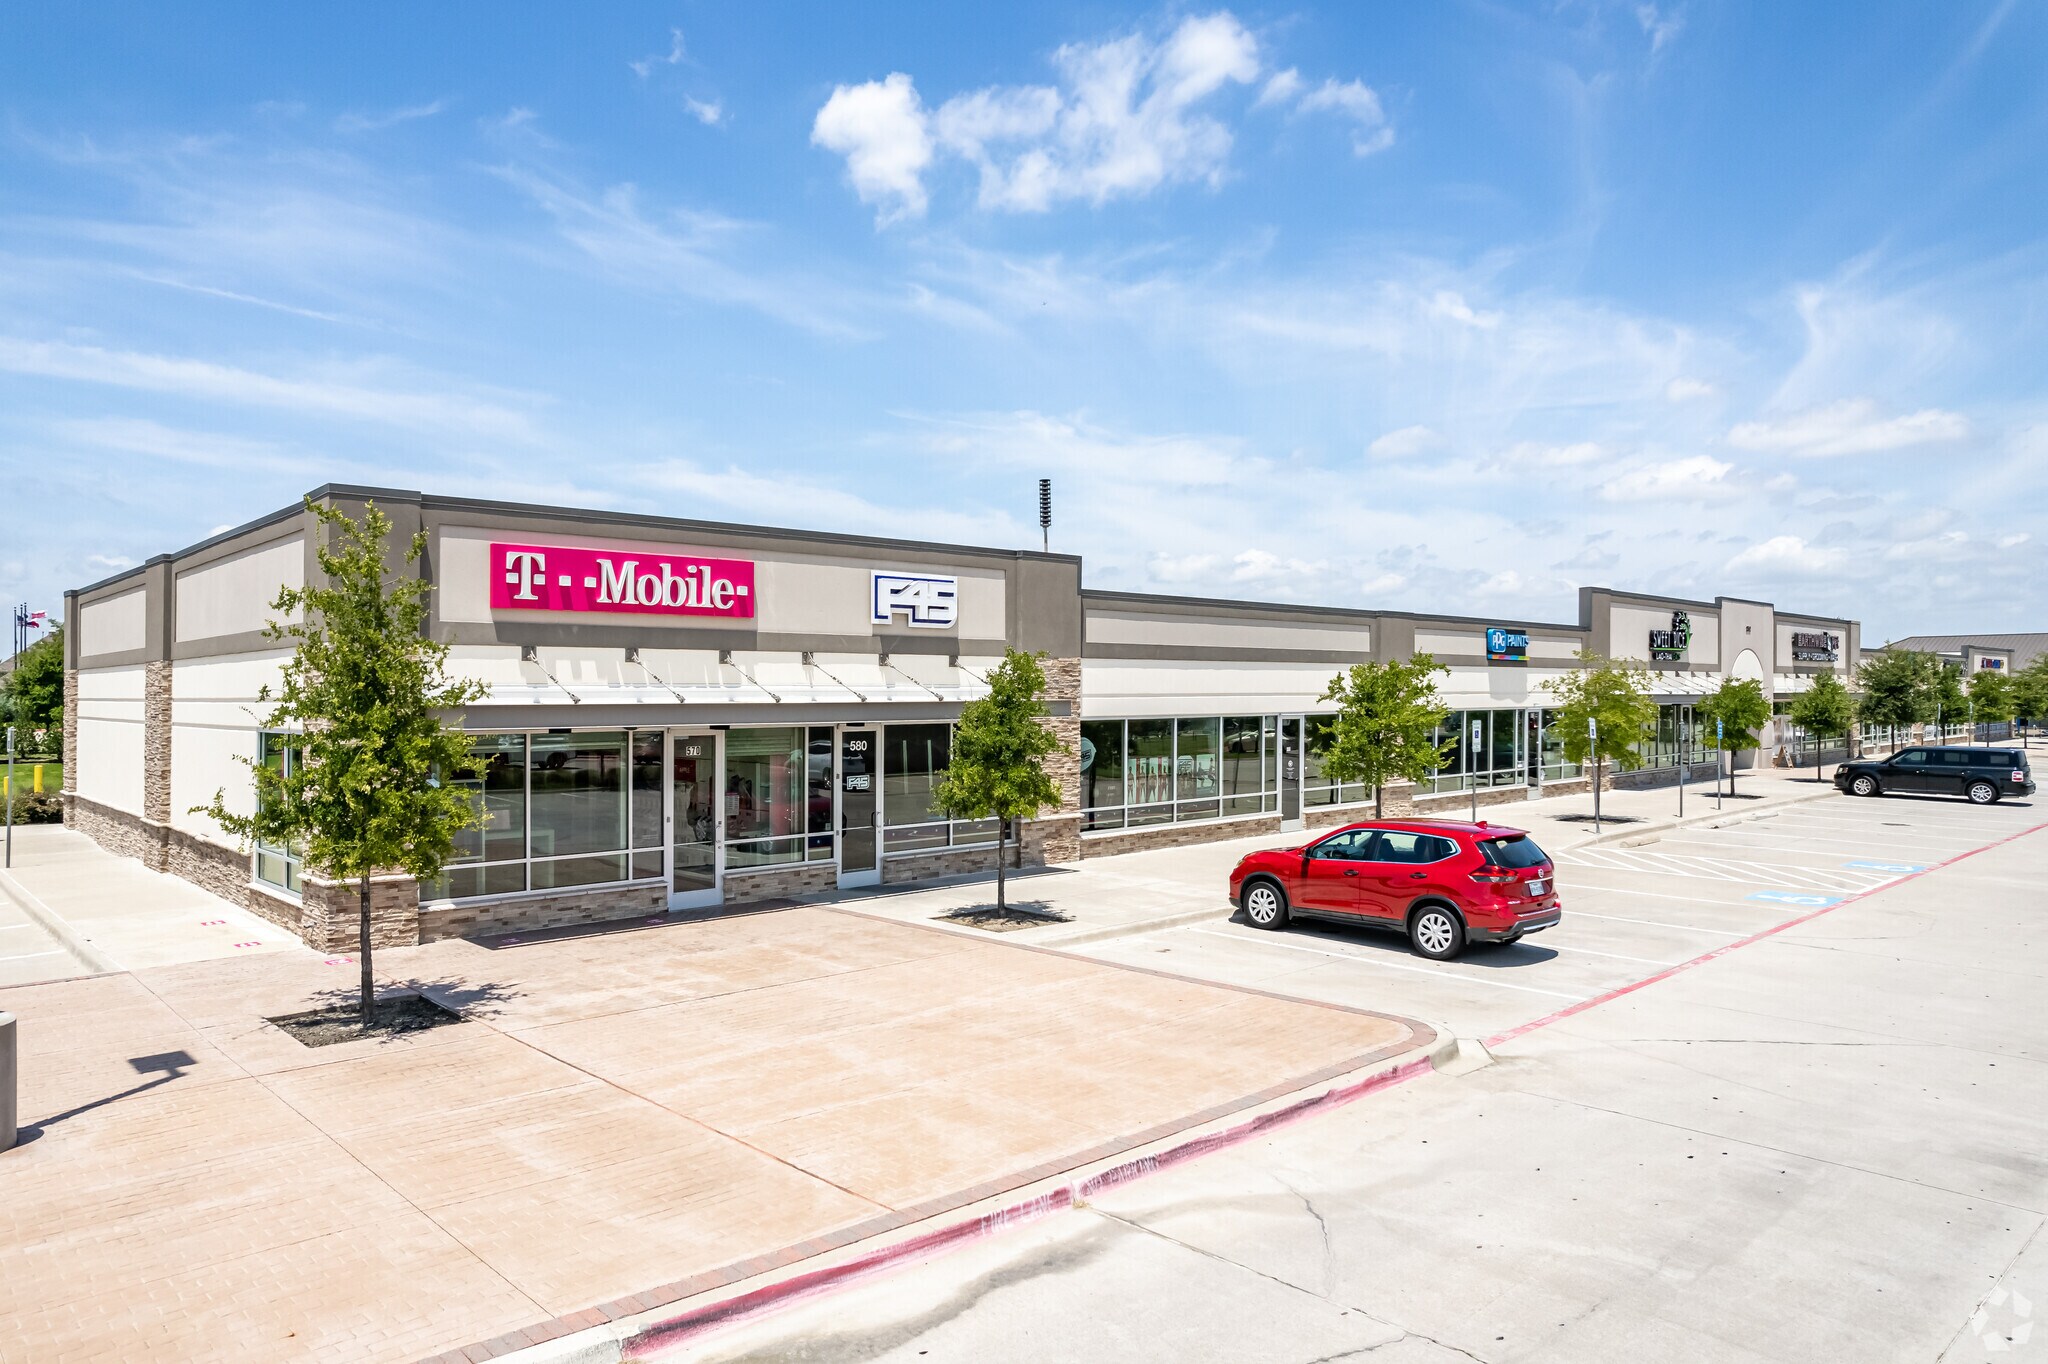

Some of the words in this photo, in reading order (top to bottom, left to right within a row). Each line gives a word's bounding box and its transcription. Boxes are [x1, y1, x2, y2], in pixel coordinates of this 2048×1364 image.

[873, 573, 957, 626] F45
[1492, 631, 1506, 649] PPG
[1507, 635, 1529, 648] PAINTS
[1653, 631, 1671, 648] SWEET
[686, 746, 701, 756] 570
[850, 741, 868, 751] 580
[847, 775, 870, 790] F45
